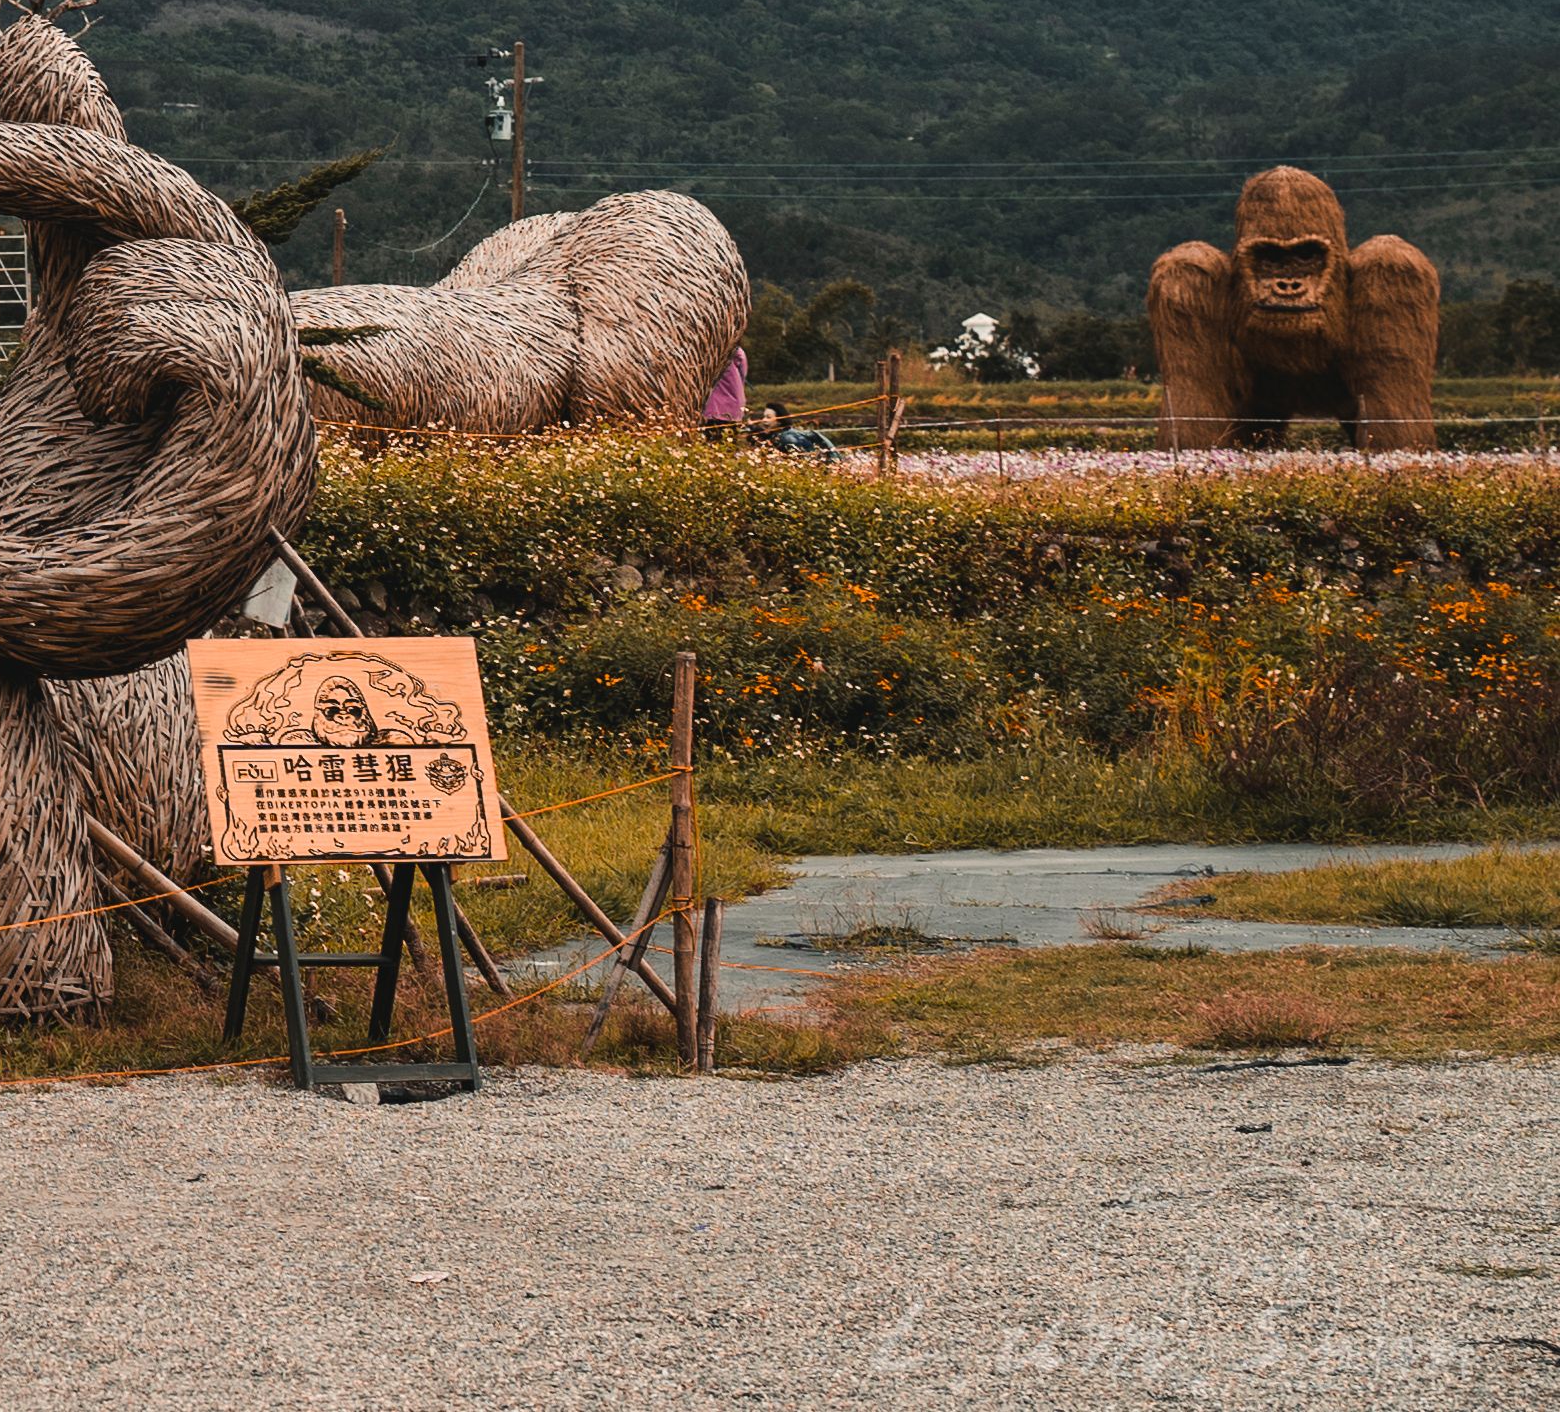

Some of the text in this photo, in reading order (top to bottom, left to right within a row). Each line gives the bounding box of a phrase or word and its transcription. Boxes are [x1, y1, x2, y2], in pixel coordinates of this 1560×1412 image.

[237, 767, 274, 779] FULI
[283, 753, 417, 783] 哈雷彗猩
